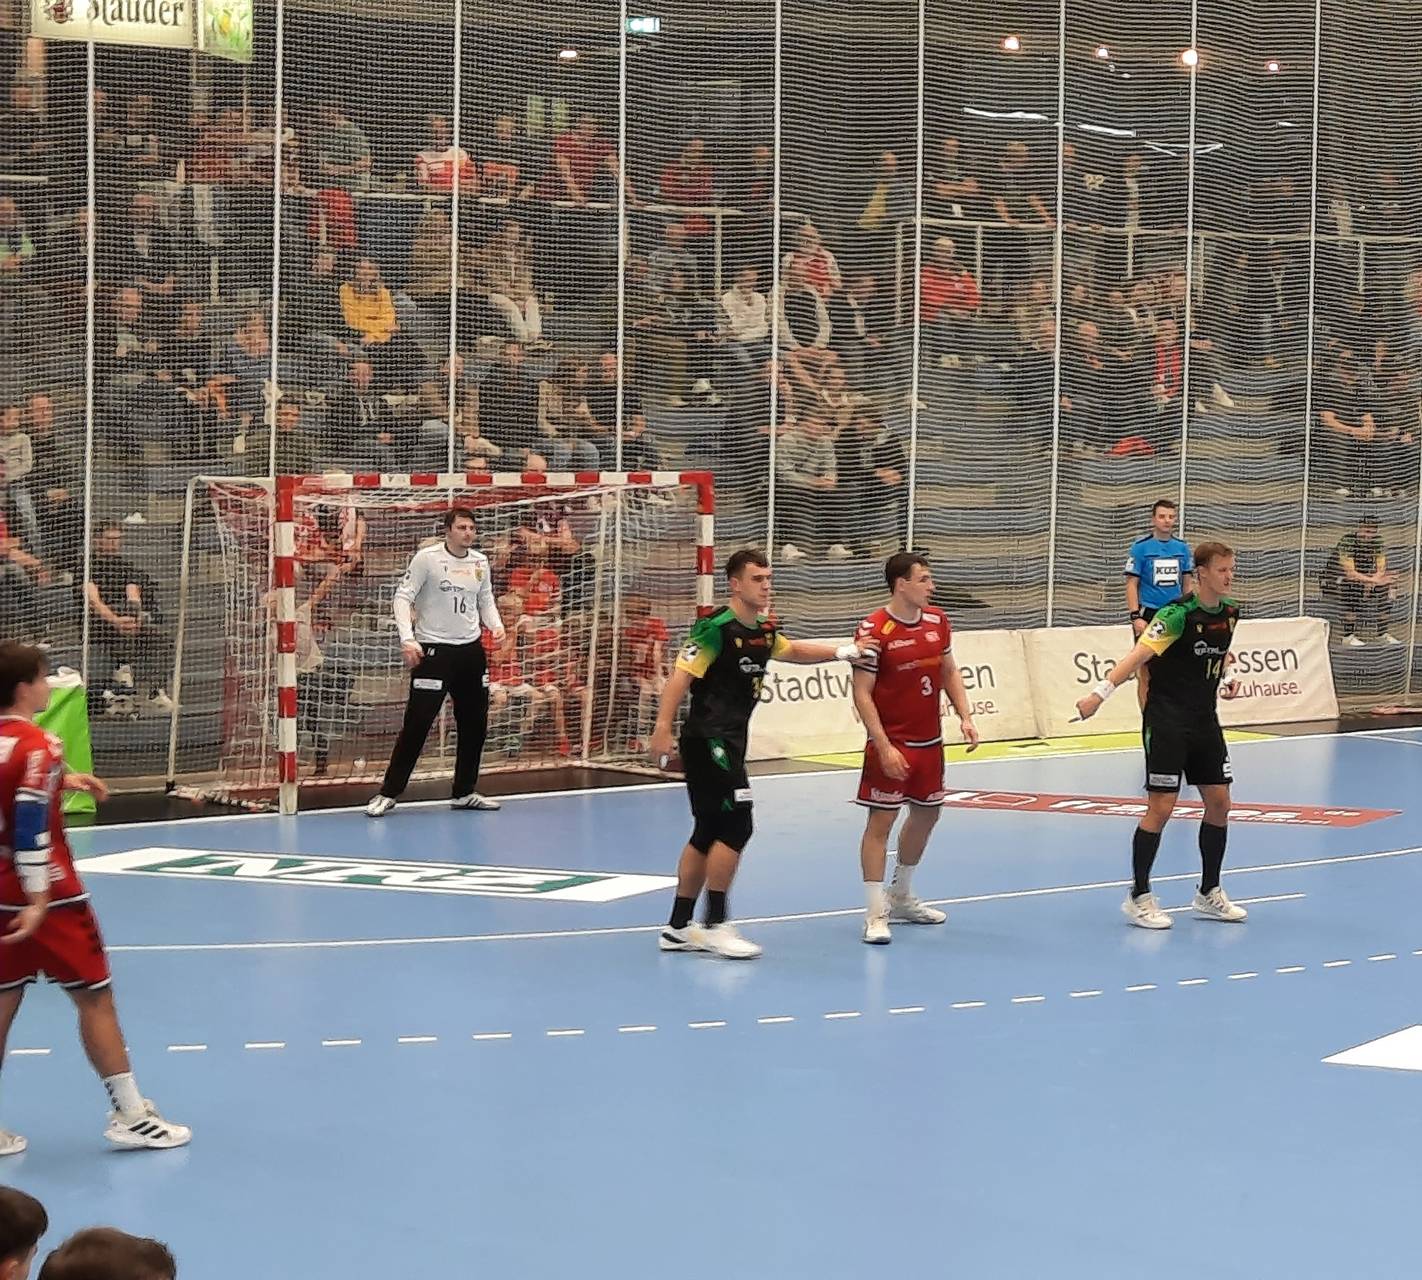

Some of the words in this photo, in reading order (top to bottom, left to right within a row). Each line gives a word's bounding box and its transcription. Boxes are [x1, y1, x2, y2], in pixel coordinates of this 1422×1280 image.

[453, 596, 466, 613] 16
[1206, 658, 1223, 680] 14
[920, 675, 933, 696] 3
